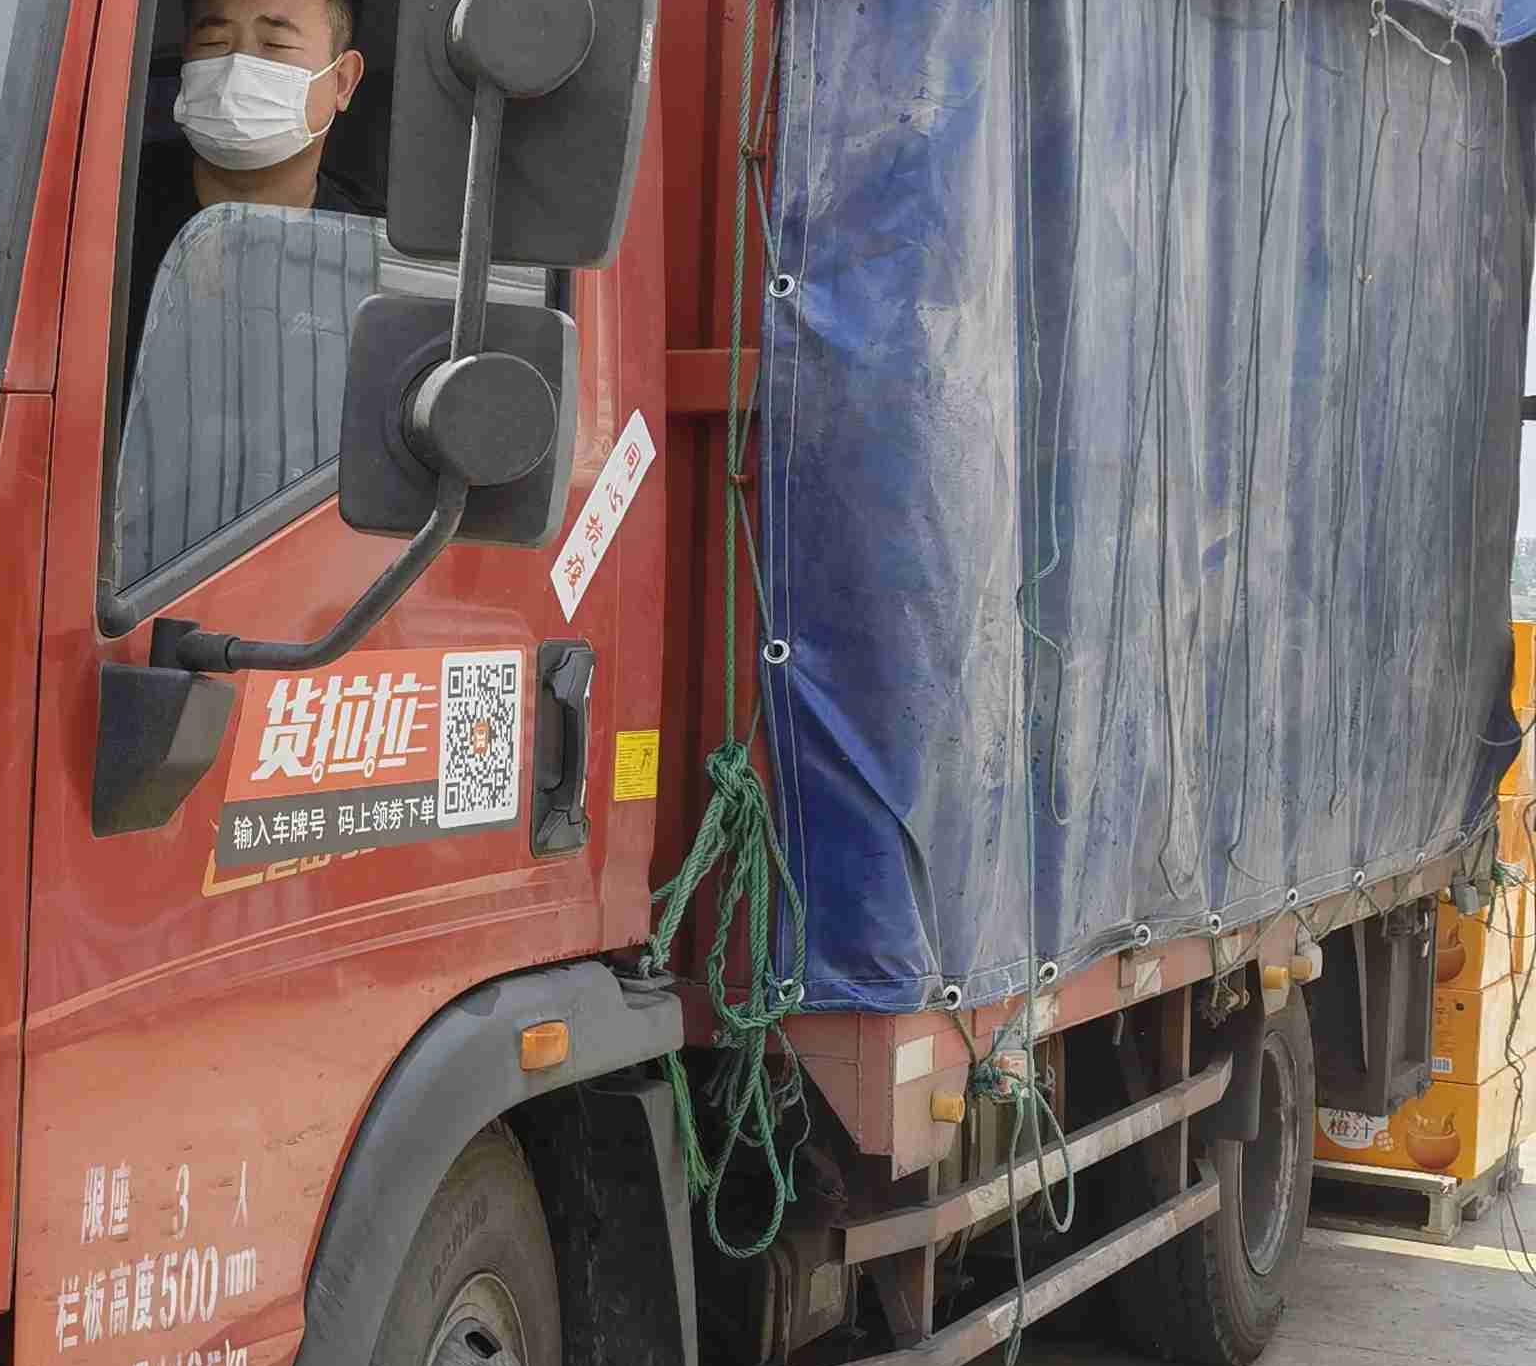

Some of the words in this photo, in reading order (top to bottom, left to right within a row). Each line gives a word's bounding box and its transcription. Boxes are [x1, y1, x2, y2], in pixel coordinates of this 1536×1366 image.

[251, 673, 426, 783] 货拉拉
[232, 808, 327, 850] 输入车牌号
